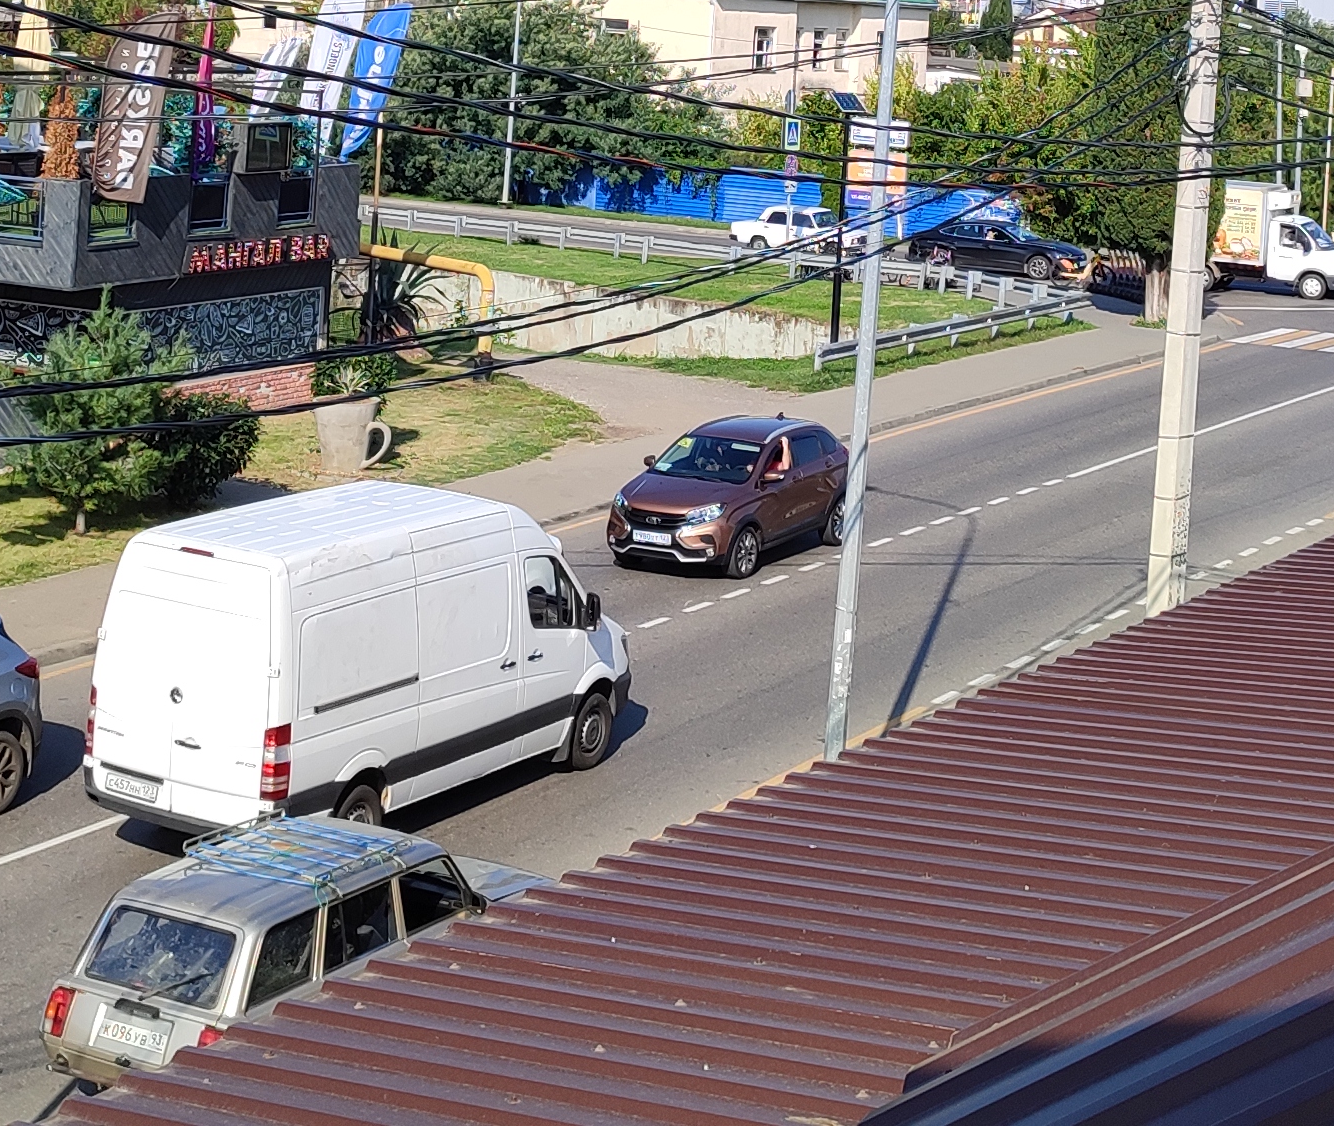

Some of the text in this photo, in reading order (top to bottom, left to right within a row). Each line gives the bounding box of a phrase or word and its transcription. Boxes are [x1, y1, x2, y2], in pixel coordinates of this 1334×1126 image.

[187, 237, 283, 274] МАНГАЛ
[103, 1023, 164, 1046] К096УВ 93
